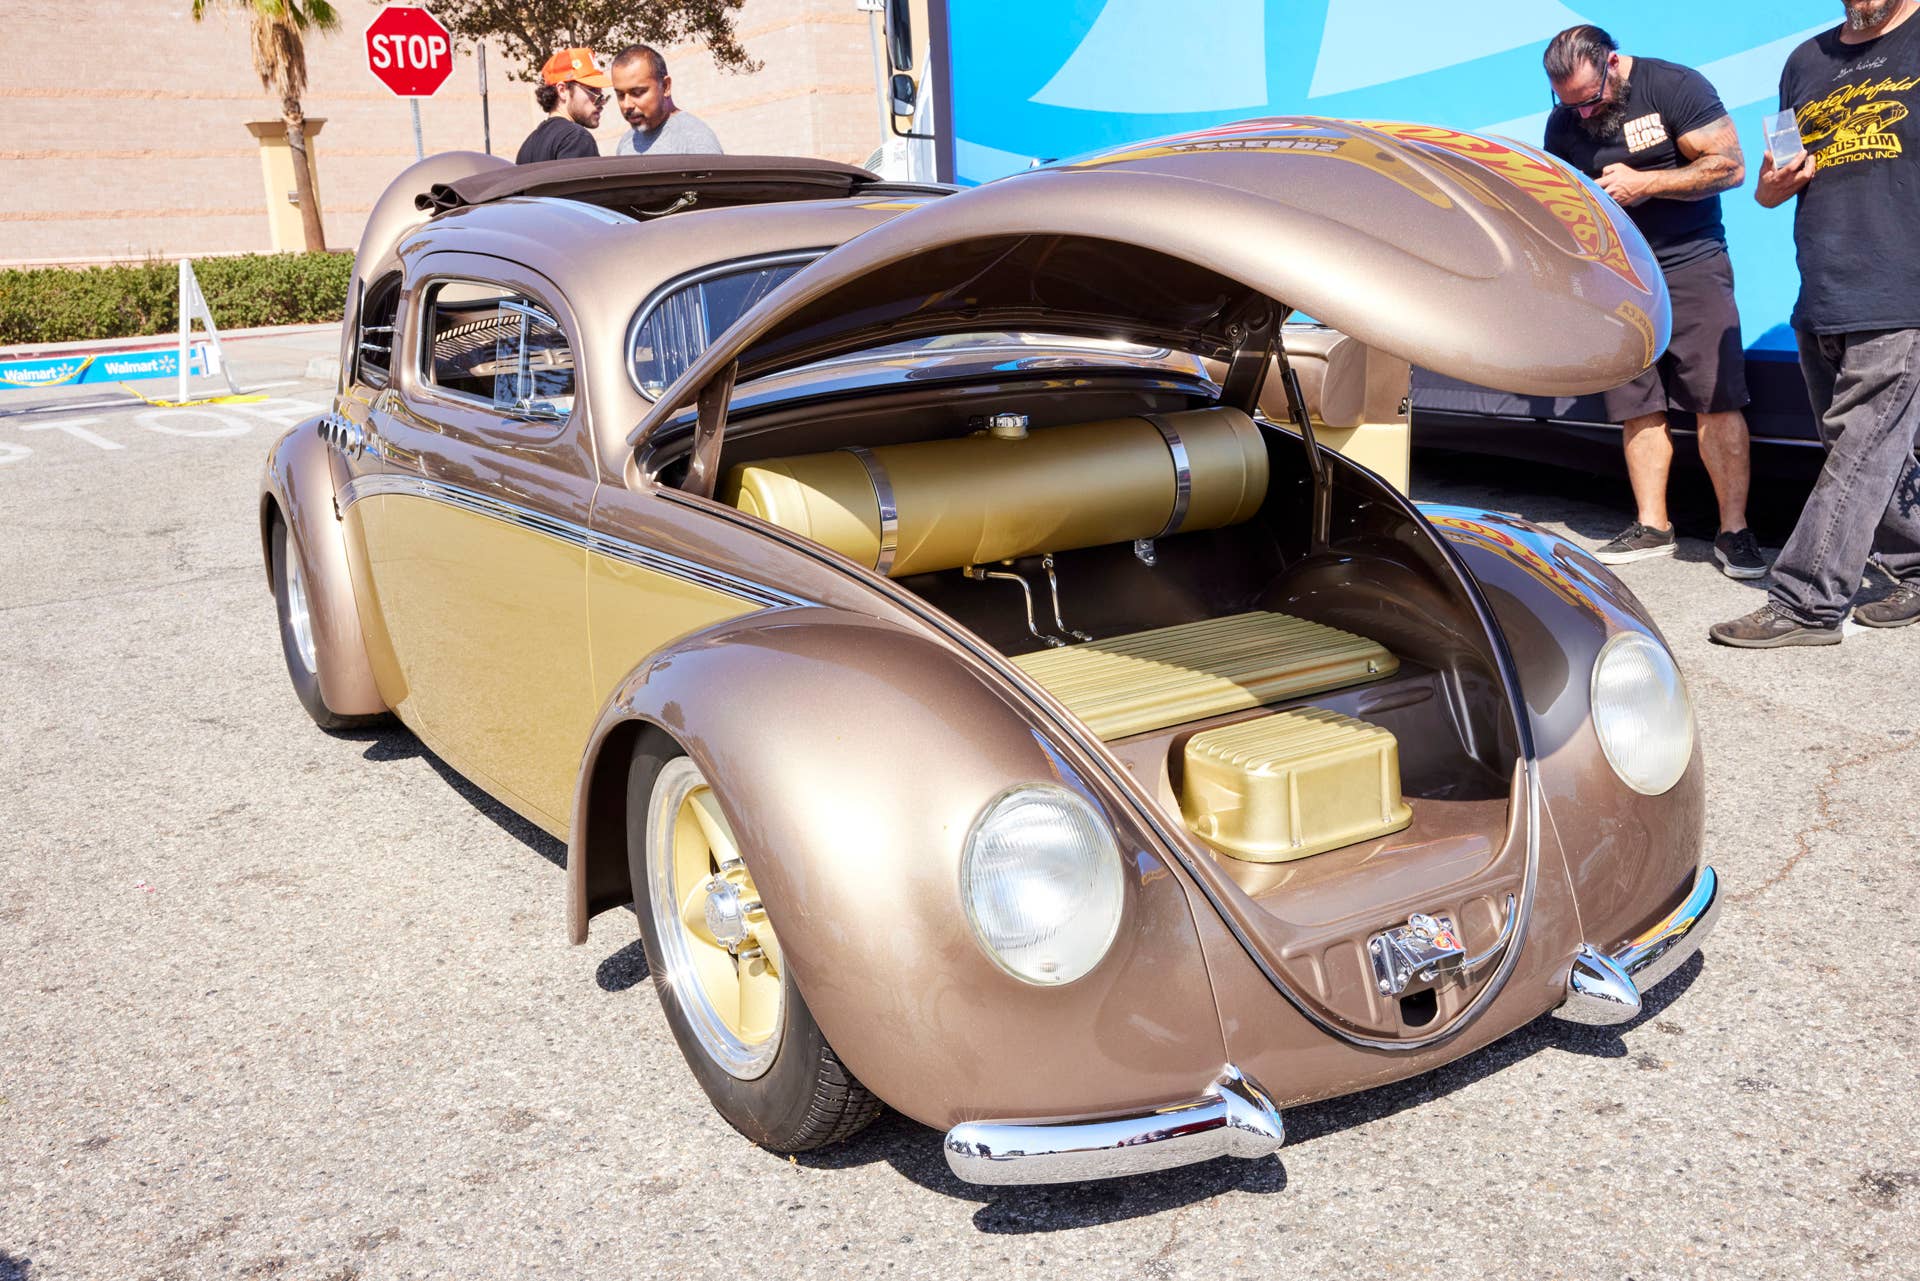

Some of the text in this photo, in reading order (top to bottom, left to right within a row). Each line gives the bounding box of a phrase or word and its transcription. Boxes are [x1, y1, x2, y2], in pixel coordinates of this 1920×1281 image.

[372, 33, 447, 69] STOP
[1624, 113, 1661, 135] MIND
[1875, 150, 1898, 159] INC.
[4, 367, 57, 381] Walmart
[104, 359, 158, 376] Walmart
